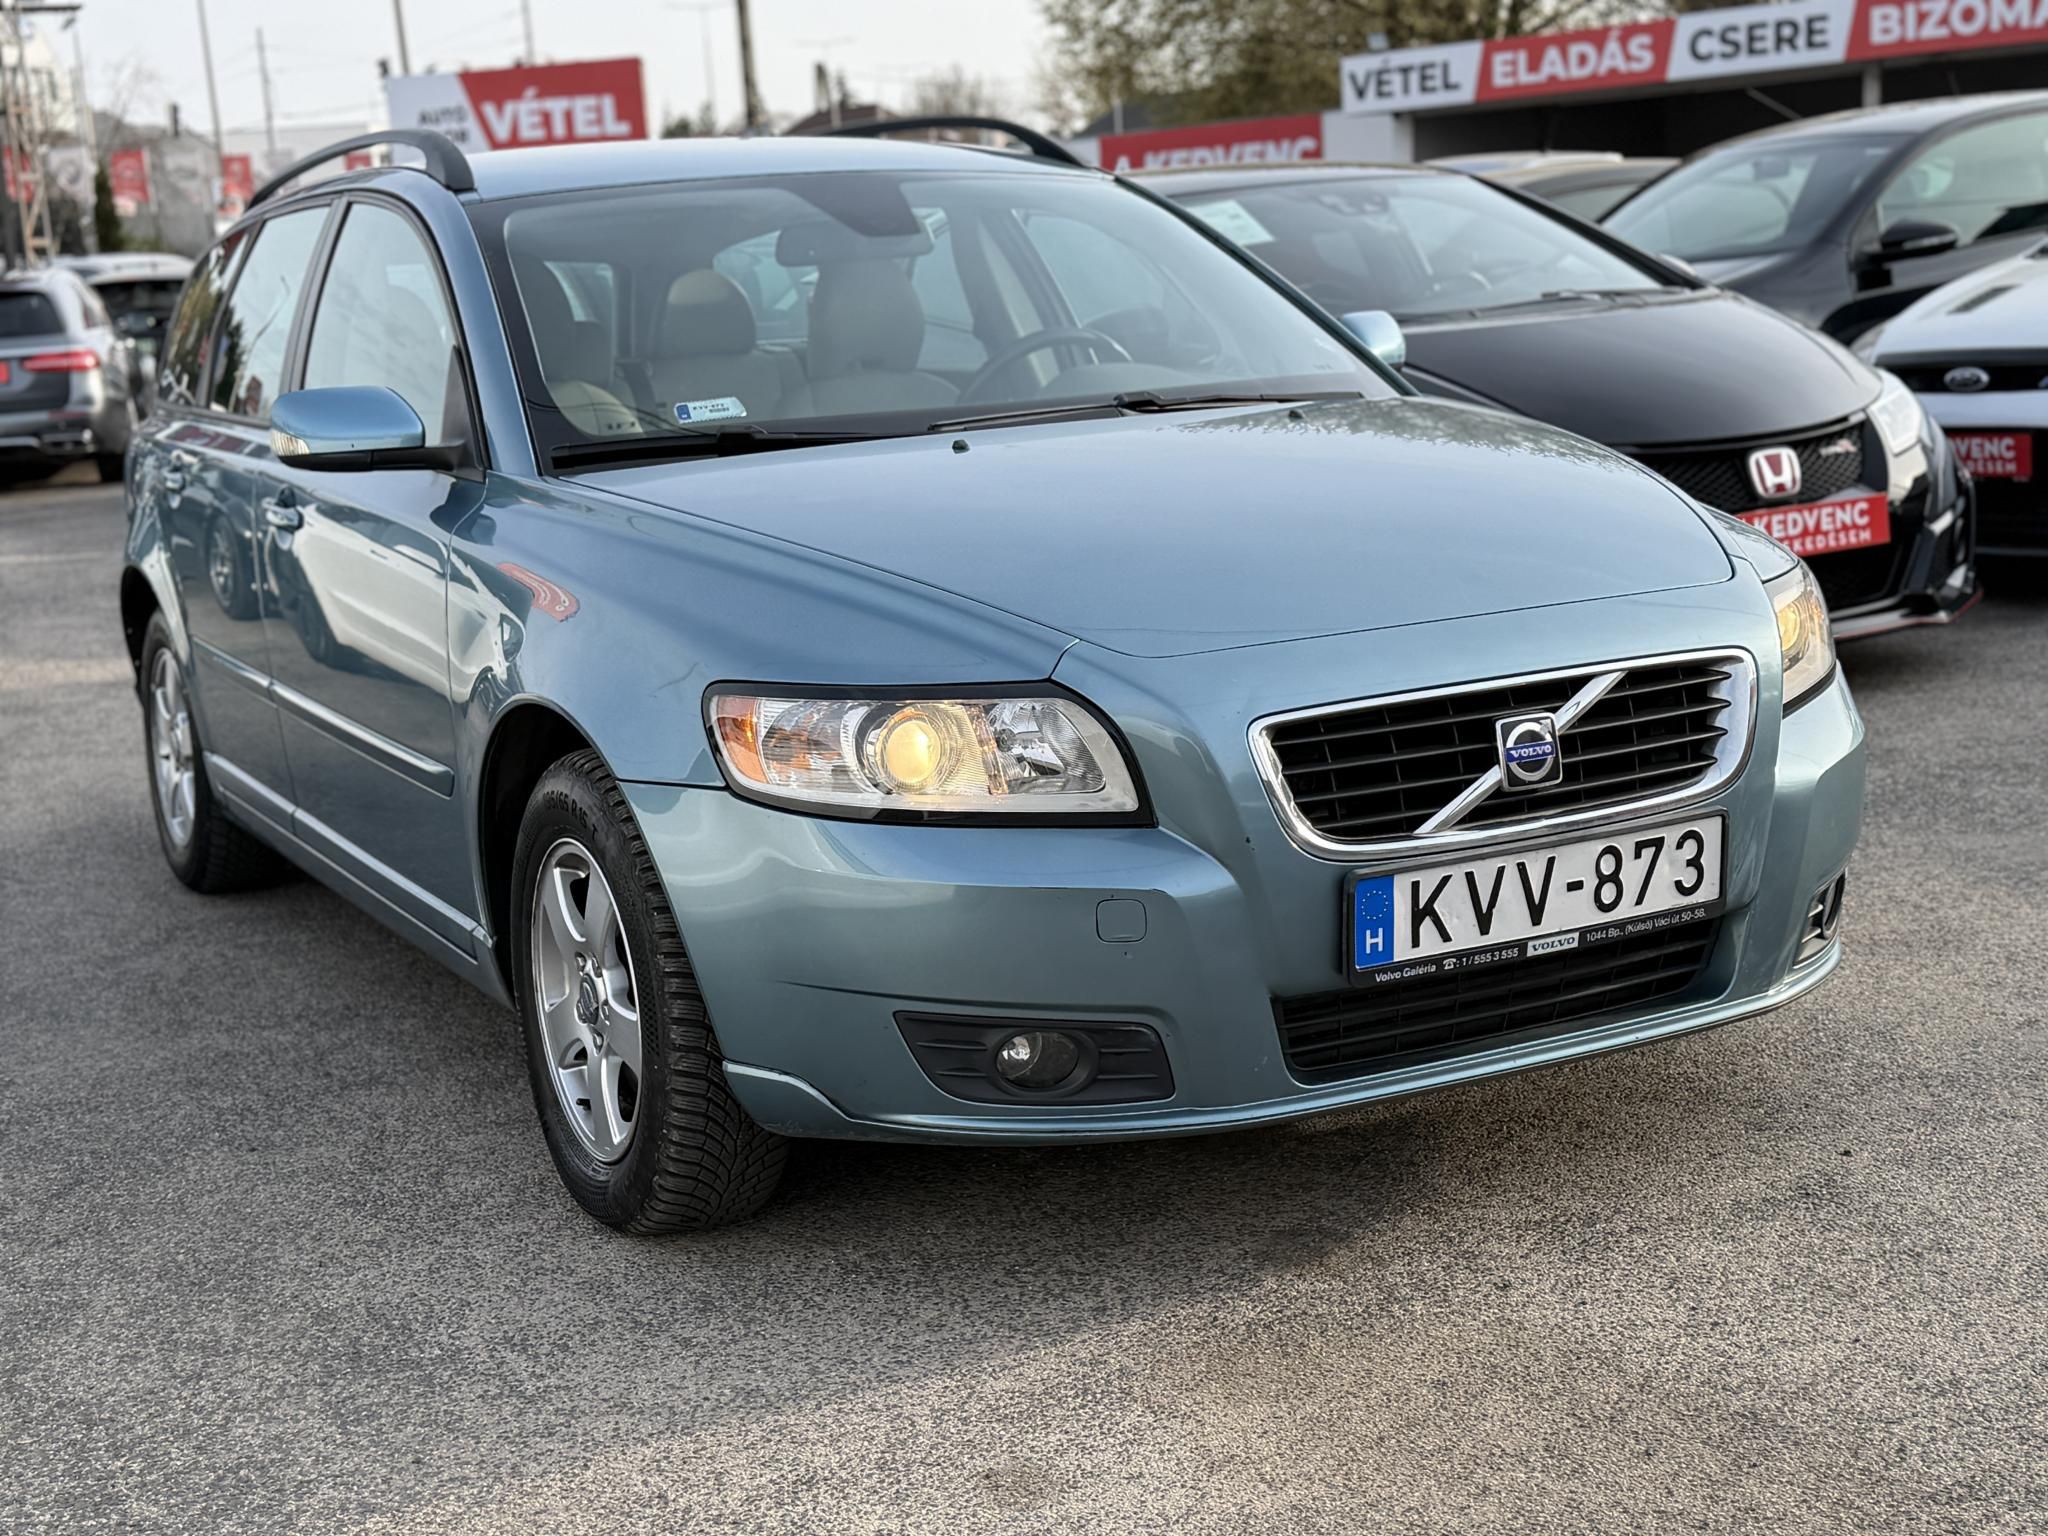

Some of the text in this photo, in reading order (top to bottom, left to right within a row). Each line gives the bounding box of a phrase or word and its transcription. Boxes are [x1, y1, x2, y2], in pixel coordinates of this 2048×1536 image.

[1349, 58, 1461, 101] VÉTEL
[1491, 26, 1655, 89] ELADÁS
[1689, 15, 1830, 62] CSERE
[480, 86, 632, 144] VÉTEL
[1510, 744, 1552, 758] VOLVO
[1410, 829, 1705, 949] KVV-873
[1365, 928, 1383, 954] H
[1375, 972, 1401, 983] Volvo
[1402, 963, 1437, 978] Galéria
[1532, 936, 1575, 952] VOLVO
[1586, 929, 1607, 942] 1044
